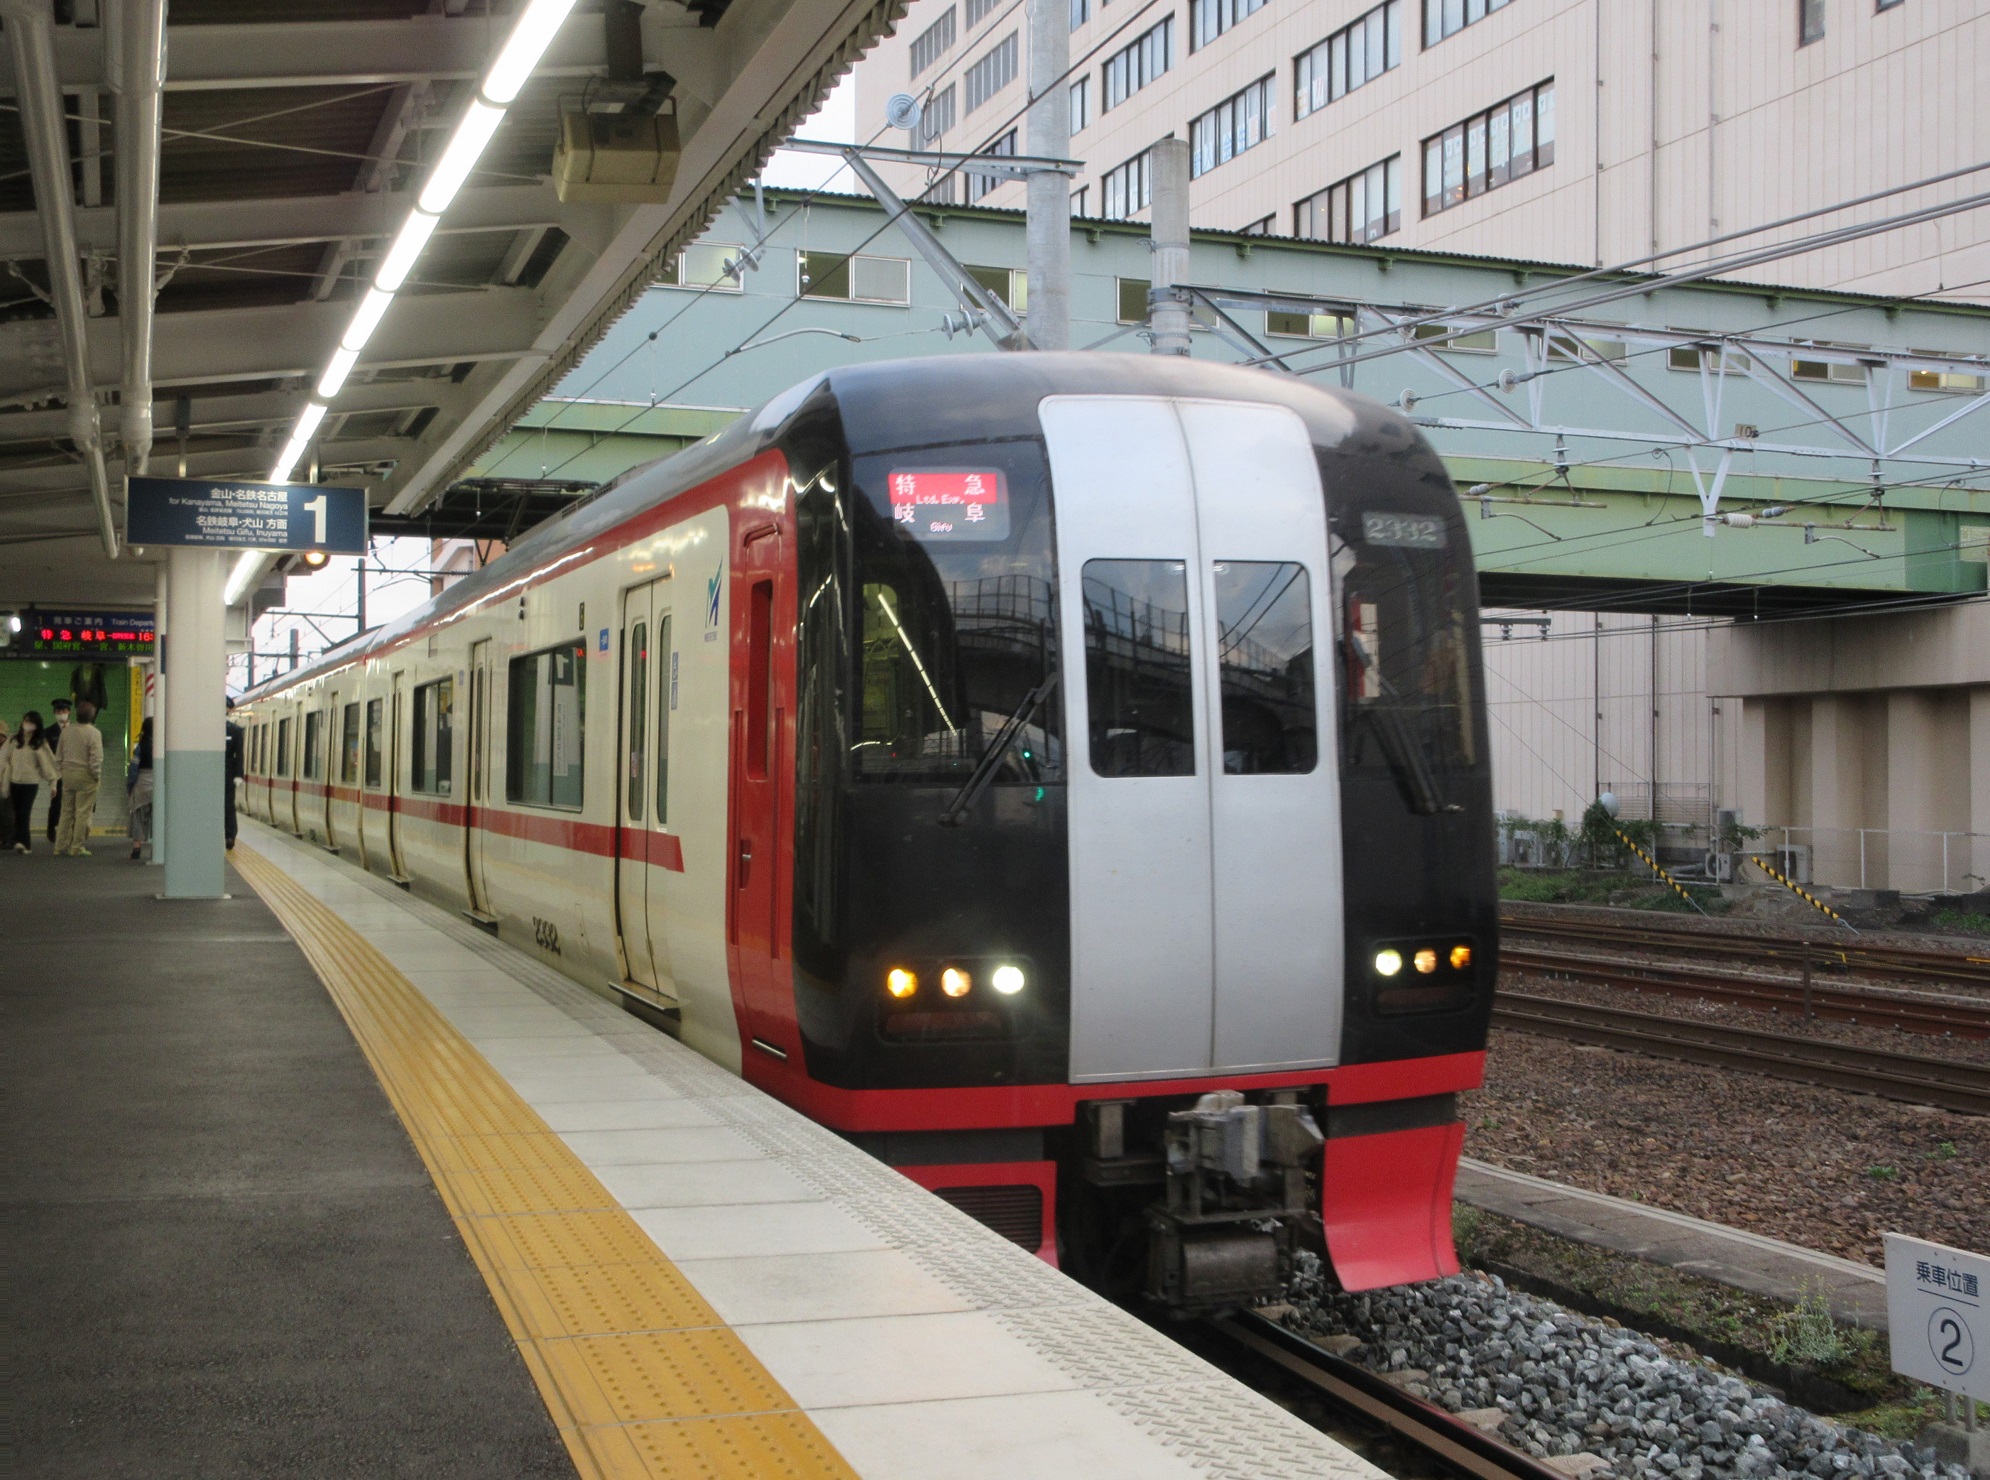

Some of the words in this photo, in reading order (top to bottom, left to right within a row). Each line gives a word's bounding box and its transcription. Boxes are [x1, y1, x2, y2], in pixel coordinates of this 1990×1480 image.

[895, 473, 985, 495] 特急
[182, 498, 222, 508] Kanayama,
[226, 500, 258, 508] Meitetsu
[260, 502, 288, 511] Nagoya
[894, 502, 986, 523] 岐阜
[266, 518, 287, 529] 方面
[304, 495, 327, 543] 1
[929, 521, 953, 533] Gifu
[203, 527, 235, 535] Meitetsu
[237, 528, 254, 536] Gifu,
[257, 529, 287, 538] Inuyama
[1366, 518, 1438, 542] 2332
[41, 629, 72, 640] 特急
[81, 629, 106, 641] 岐阜
[532, 915, 562, 956] 2332
[1916, 1260, 1979, 1298] 乗車位置
